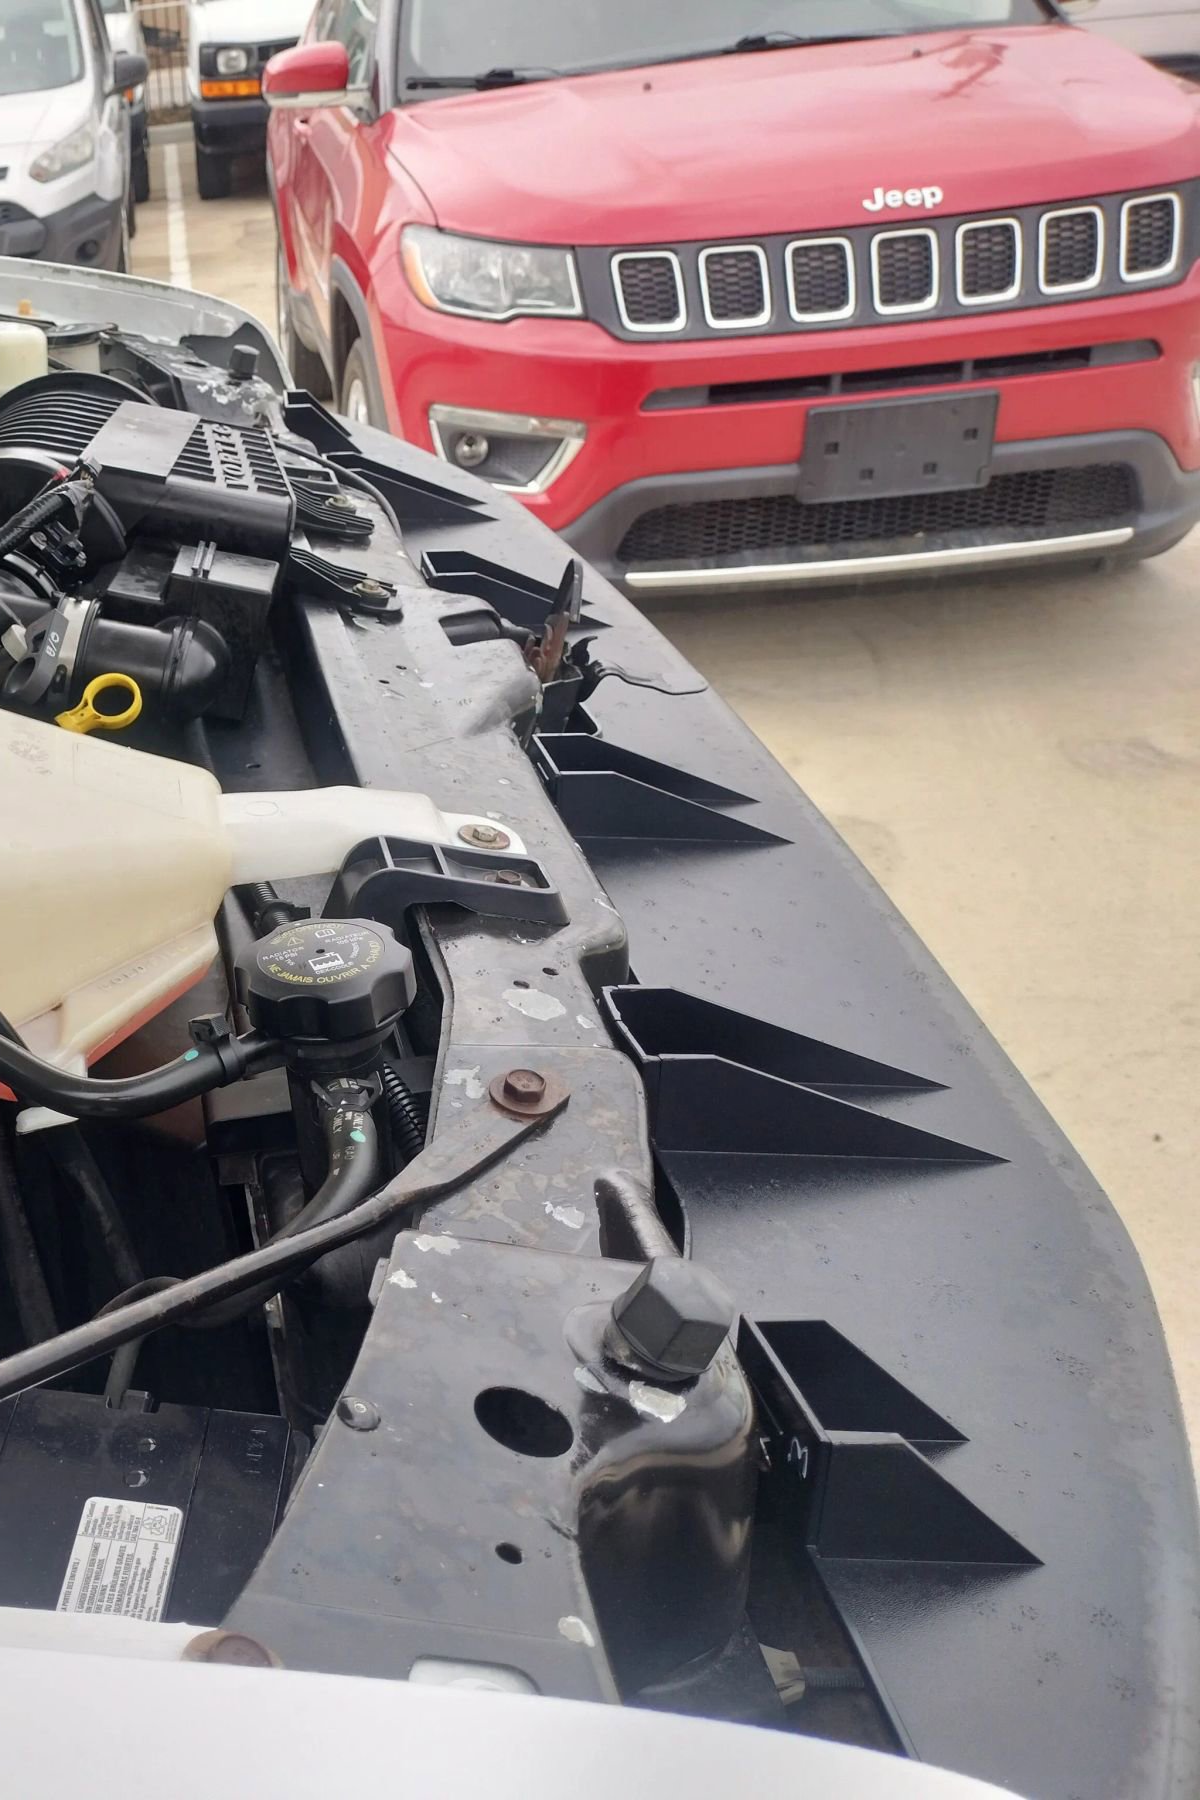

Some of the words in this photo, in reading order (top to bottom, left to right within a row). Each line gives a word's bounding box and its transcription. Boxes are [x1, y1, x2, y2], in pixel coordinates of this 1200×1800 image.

[862, 185, 943, 212] Jeep
[211, 423, 249, 486] VORTEC
[262, 946, 304, 961] RADIATOR
[277, 970, 314, 984] JAMAIS
[316, 967, 361, 984] OUVRIR
[107, 1593, 115, 1603] DES
[113, 1576, 128, 1613] QUEMADURAS
